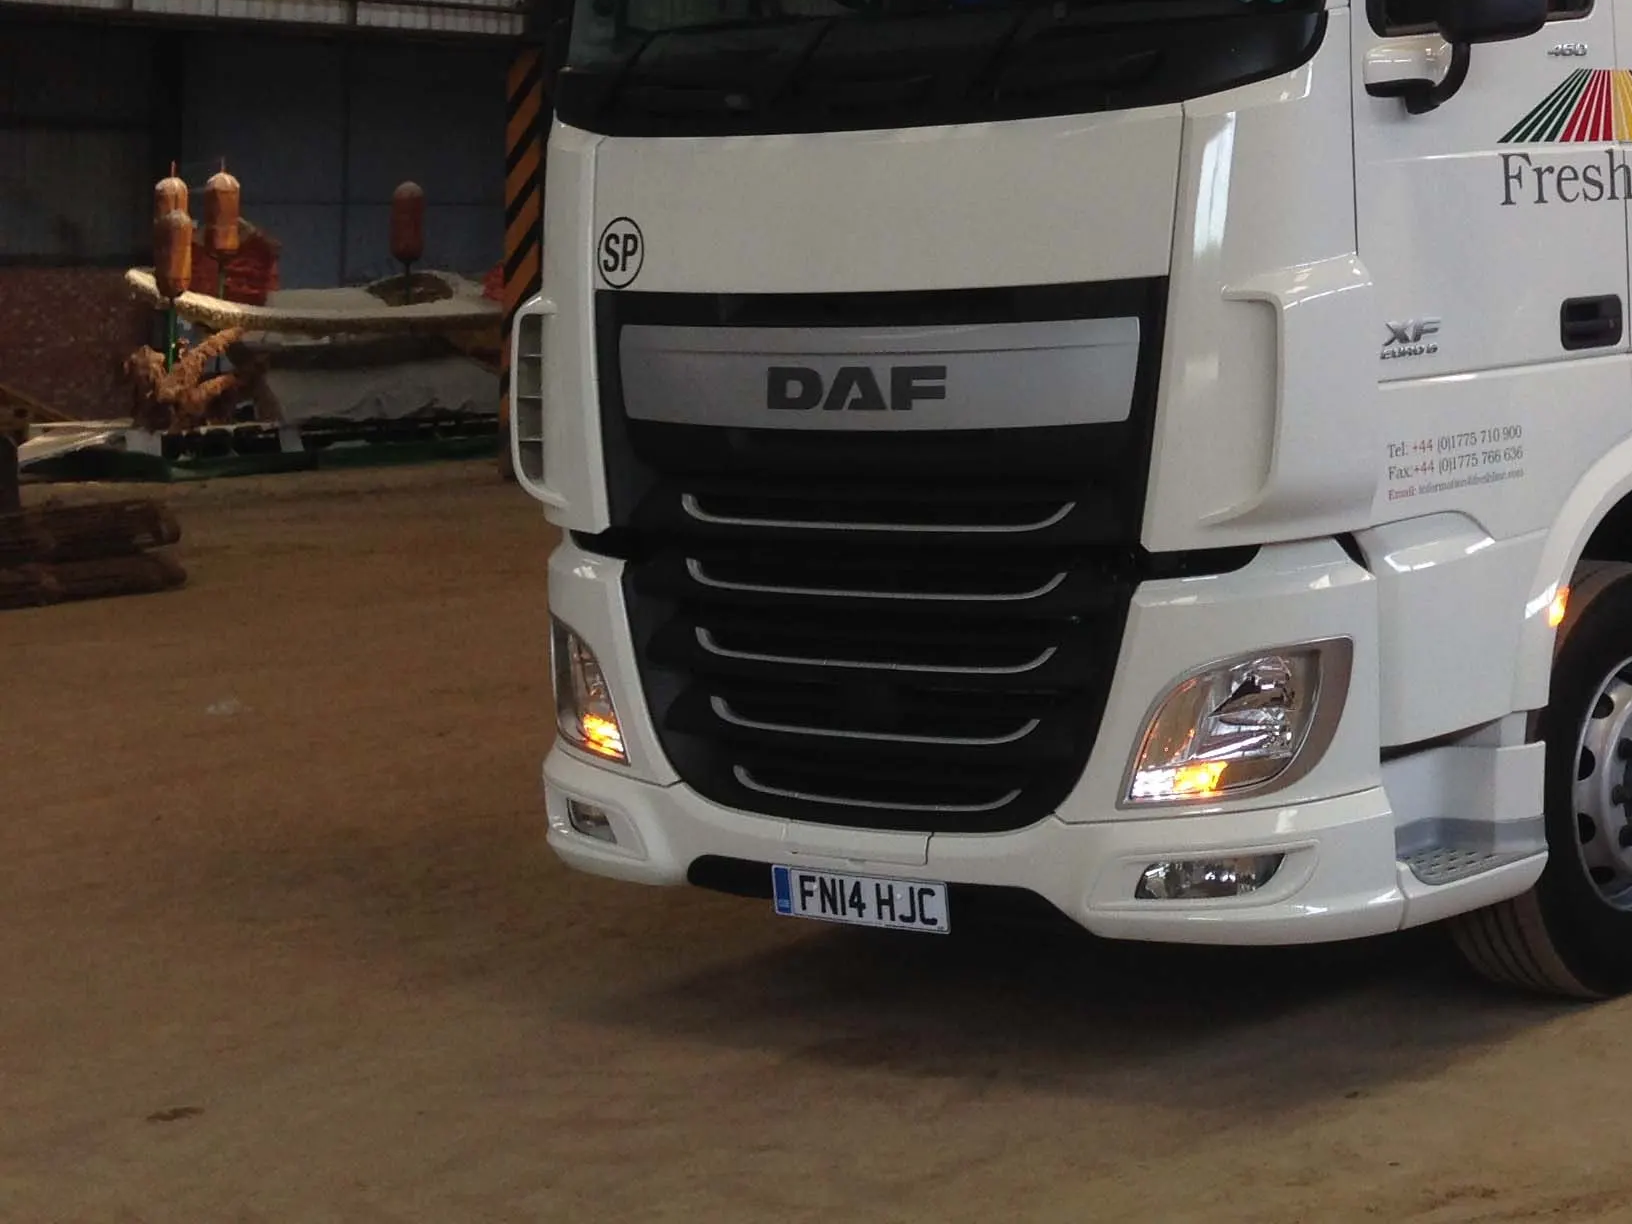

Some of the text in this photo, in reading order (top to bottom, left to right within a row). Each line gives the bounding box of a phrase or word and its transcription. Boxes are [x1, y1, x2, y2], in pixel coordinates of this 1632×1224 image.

[603, 233, 638, 273] SP
[1382, 318, 1441, 347] XF
[766, 366, 948, 411] DAF
[1437, 431, 1478, 454] (0)1775
[1479, 426, 1501, 445] 710
[1502, 424, 1523, 441] 900
[1438, 451, 1480, 476] (0)1775
[799, 874, 939, 927] FN14 HJC
